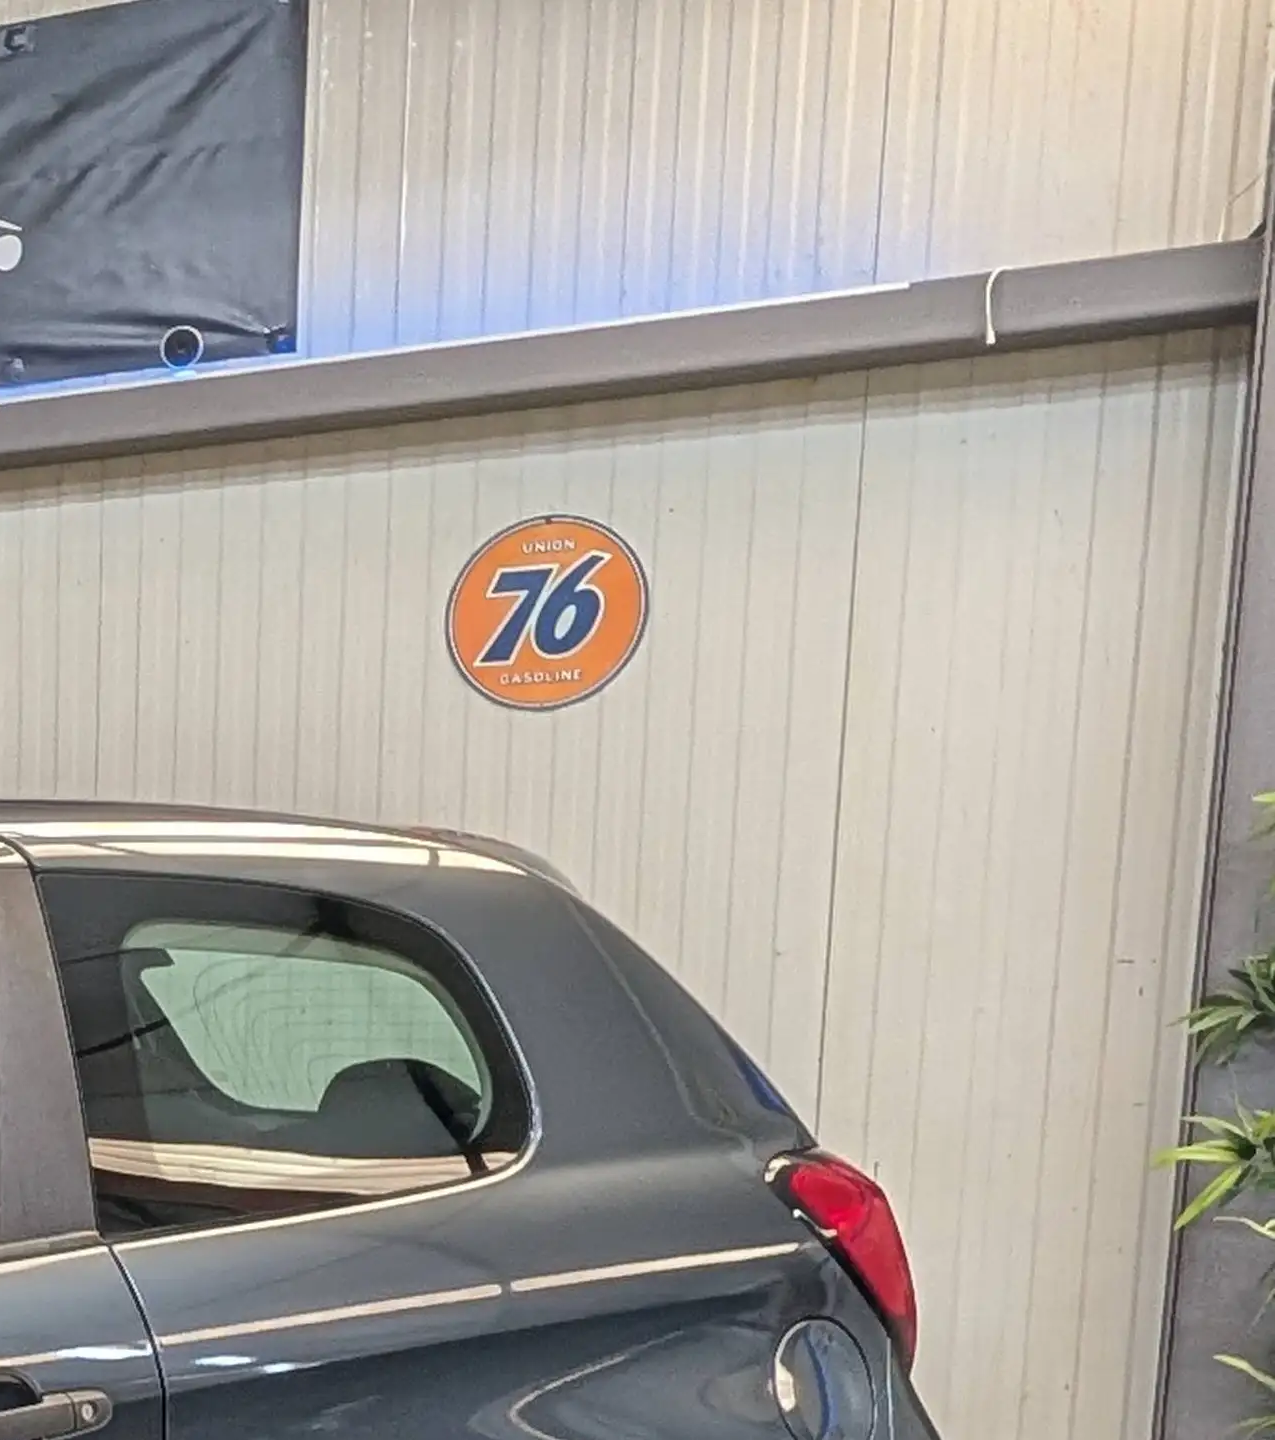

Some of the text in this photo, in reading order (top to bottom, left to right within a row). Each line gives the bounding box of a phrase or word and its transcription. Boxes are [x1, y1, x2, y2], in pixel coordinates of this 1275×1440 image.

[522, 538, 576, 554] UNION
[472, 549, 613, 667] 76
[500, 668, 582, 685] GASOLINE
